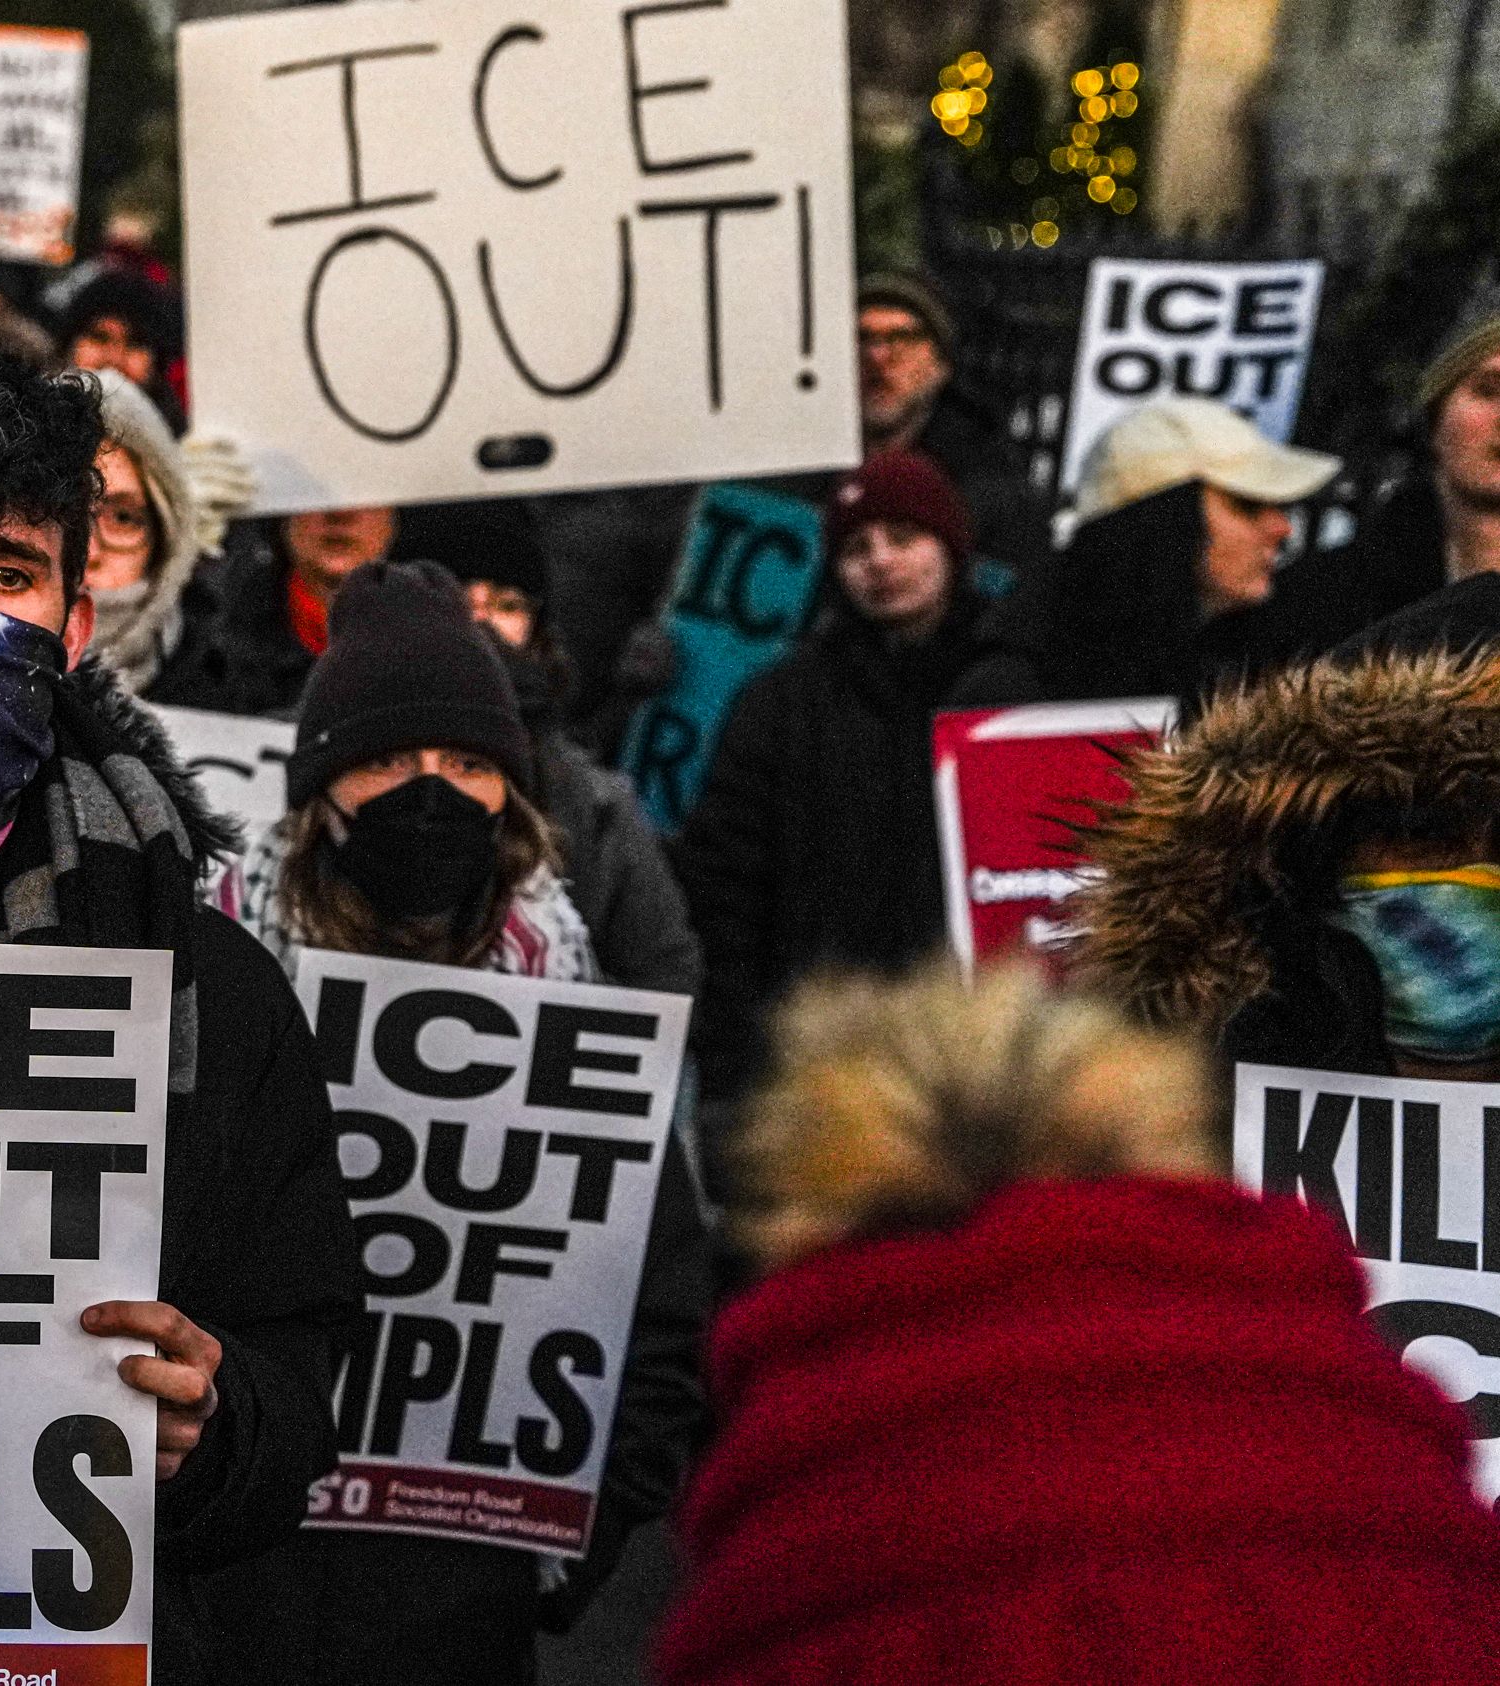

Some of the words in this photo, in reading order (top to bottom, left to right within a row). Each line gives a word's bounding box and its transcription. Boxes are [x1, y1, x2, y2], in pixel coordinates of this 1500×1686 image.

[266, 0, 756, 229] ICE
[304, 180, 817, 443] OUT!
[1105, 278, 1303, 338] ICE
[1096, 350, 1297, 398] OUT
[313, 975, 660, 1119] ICE
[1263, 1087, 1500, 1273] KIL
[353, 1211, 569, 1307] OF
[387, 1480, 470, 1505] Freedom
